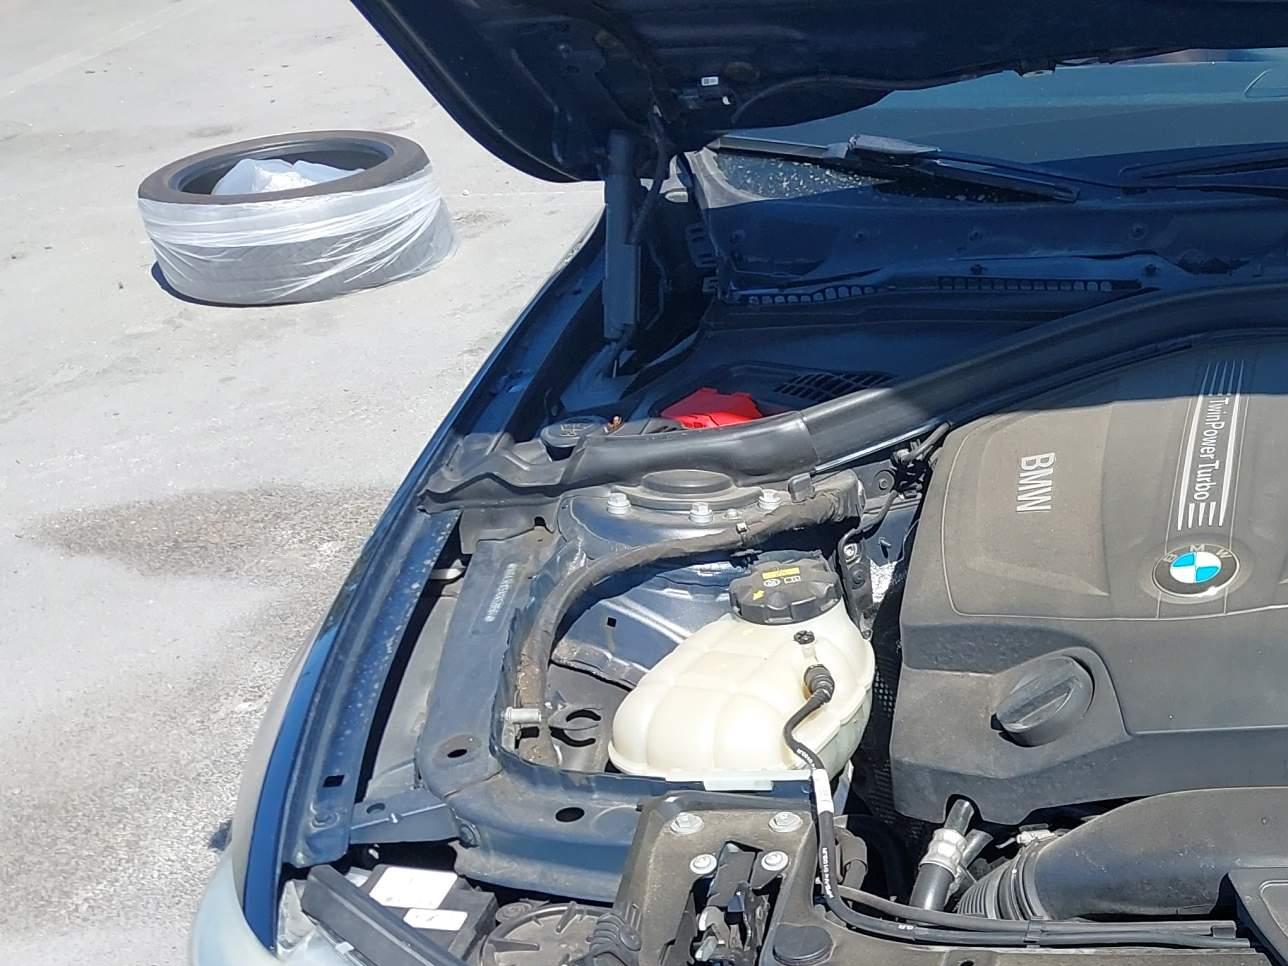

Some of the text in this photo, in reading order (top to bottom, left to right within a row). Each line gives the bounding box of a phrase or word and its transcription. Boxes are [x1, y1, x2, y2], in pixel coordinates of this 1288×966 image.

[1194, 397, 1229, 501] TwinPower Turbo
[1016, 452, 1056, 513] BMW
[1163, 543, 1232, 563] BMW
